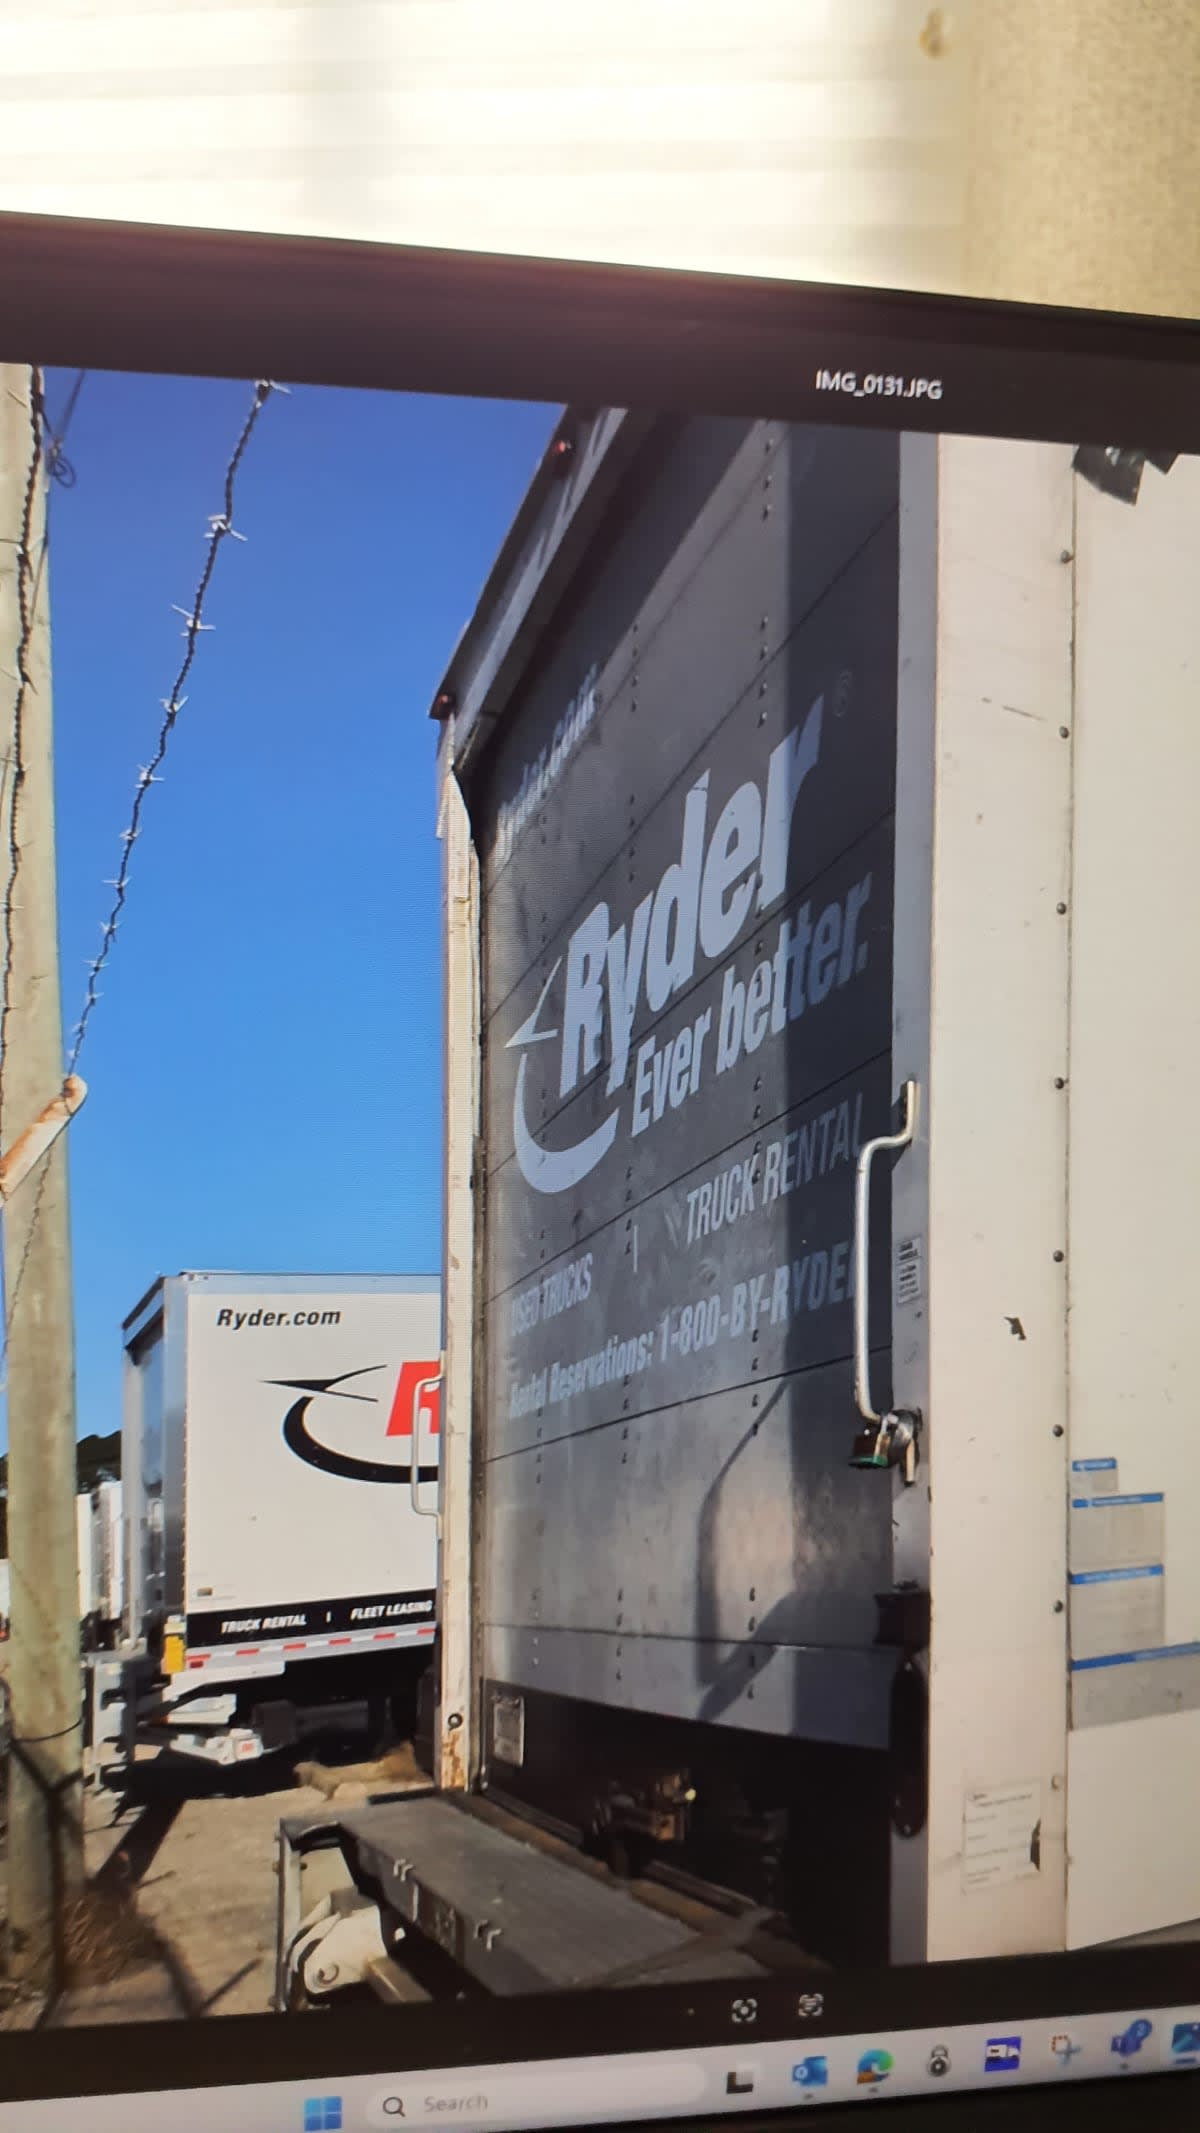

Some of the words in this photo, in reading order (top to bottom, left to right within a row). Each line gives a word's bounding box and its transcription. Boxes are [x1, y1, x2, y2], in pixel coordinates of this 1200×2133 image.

[815, 369, 943, 400] IMG_0131.JPG
[559, 693, 825, 1099] Ryder
[632, 1008, 711, 1138] Ever
[716, 872, 872, 1076] better.
[686, 1153, 760, 1245] TRUCK
[762, 1092, 864, 1206] RENTAL
[542, 1252, 594, 1320] TRUCKS
[216, 1308, 342, 1331] Ryder.com
[221, 1618, 260, 1634] TRUCK
[261, 1614, 307, 1630] RENTAL
[351, 1606, 385, 1620] FLEET
[386, 1600, 433, 1616] LEASING
[423, 2093, 489, 2112] Search
